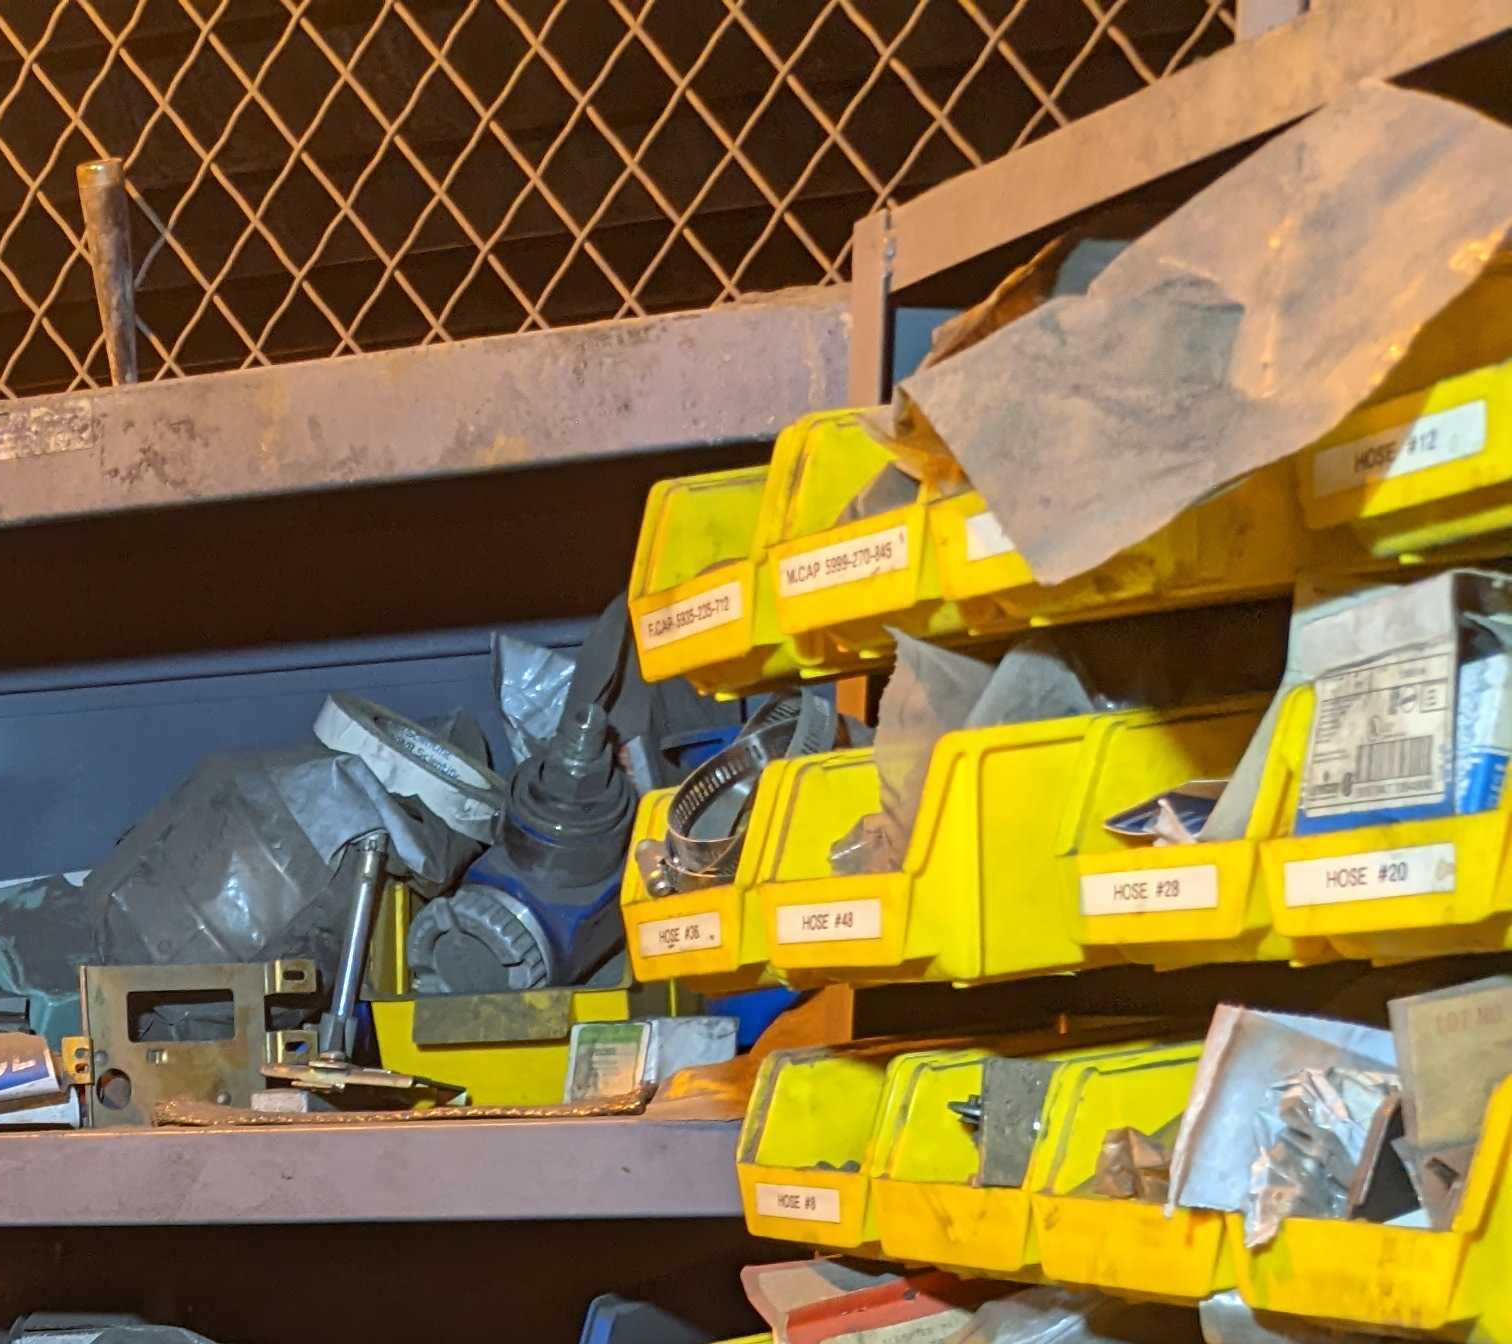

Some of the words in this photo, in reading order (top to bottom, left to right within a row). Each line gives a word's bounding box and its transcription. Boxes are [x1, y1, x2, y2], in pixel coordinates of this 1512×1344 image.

[1354, 443, 1396, 472] HOSE
[1406, 429, 1438, 457] #12
[1325, 869, 1368, 890] HOSE
[1378, 862, 1408, 885] #20
[1113, 883, 1148, 900] HOSE
[802, 913, 829, 931] HOSE
[658, 928, 680, 944] HOSE
